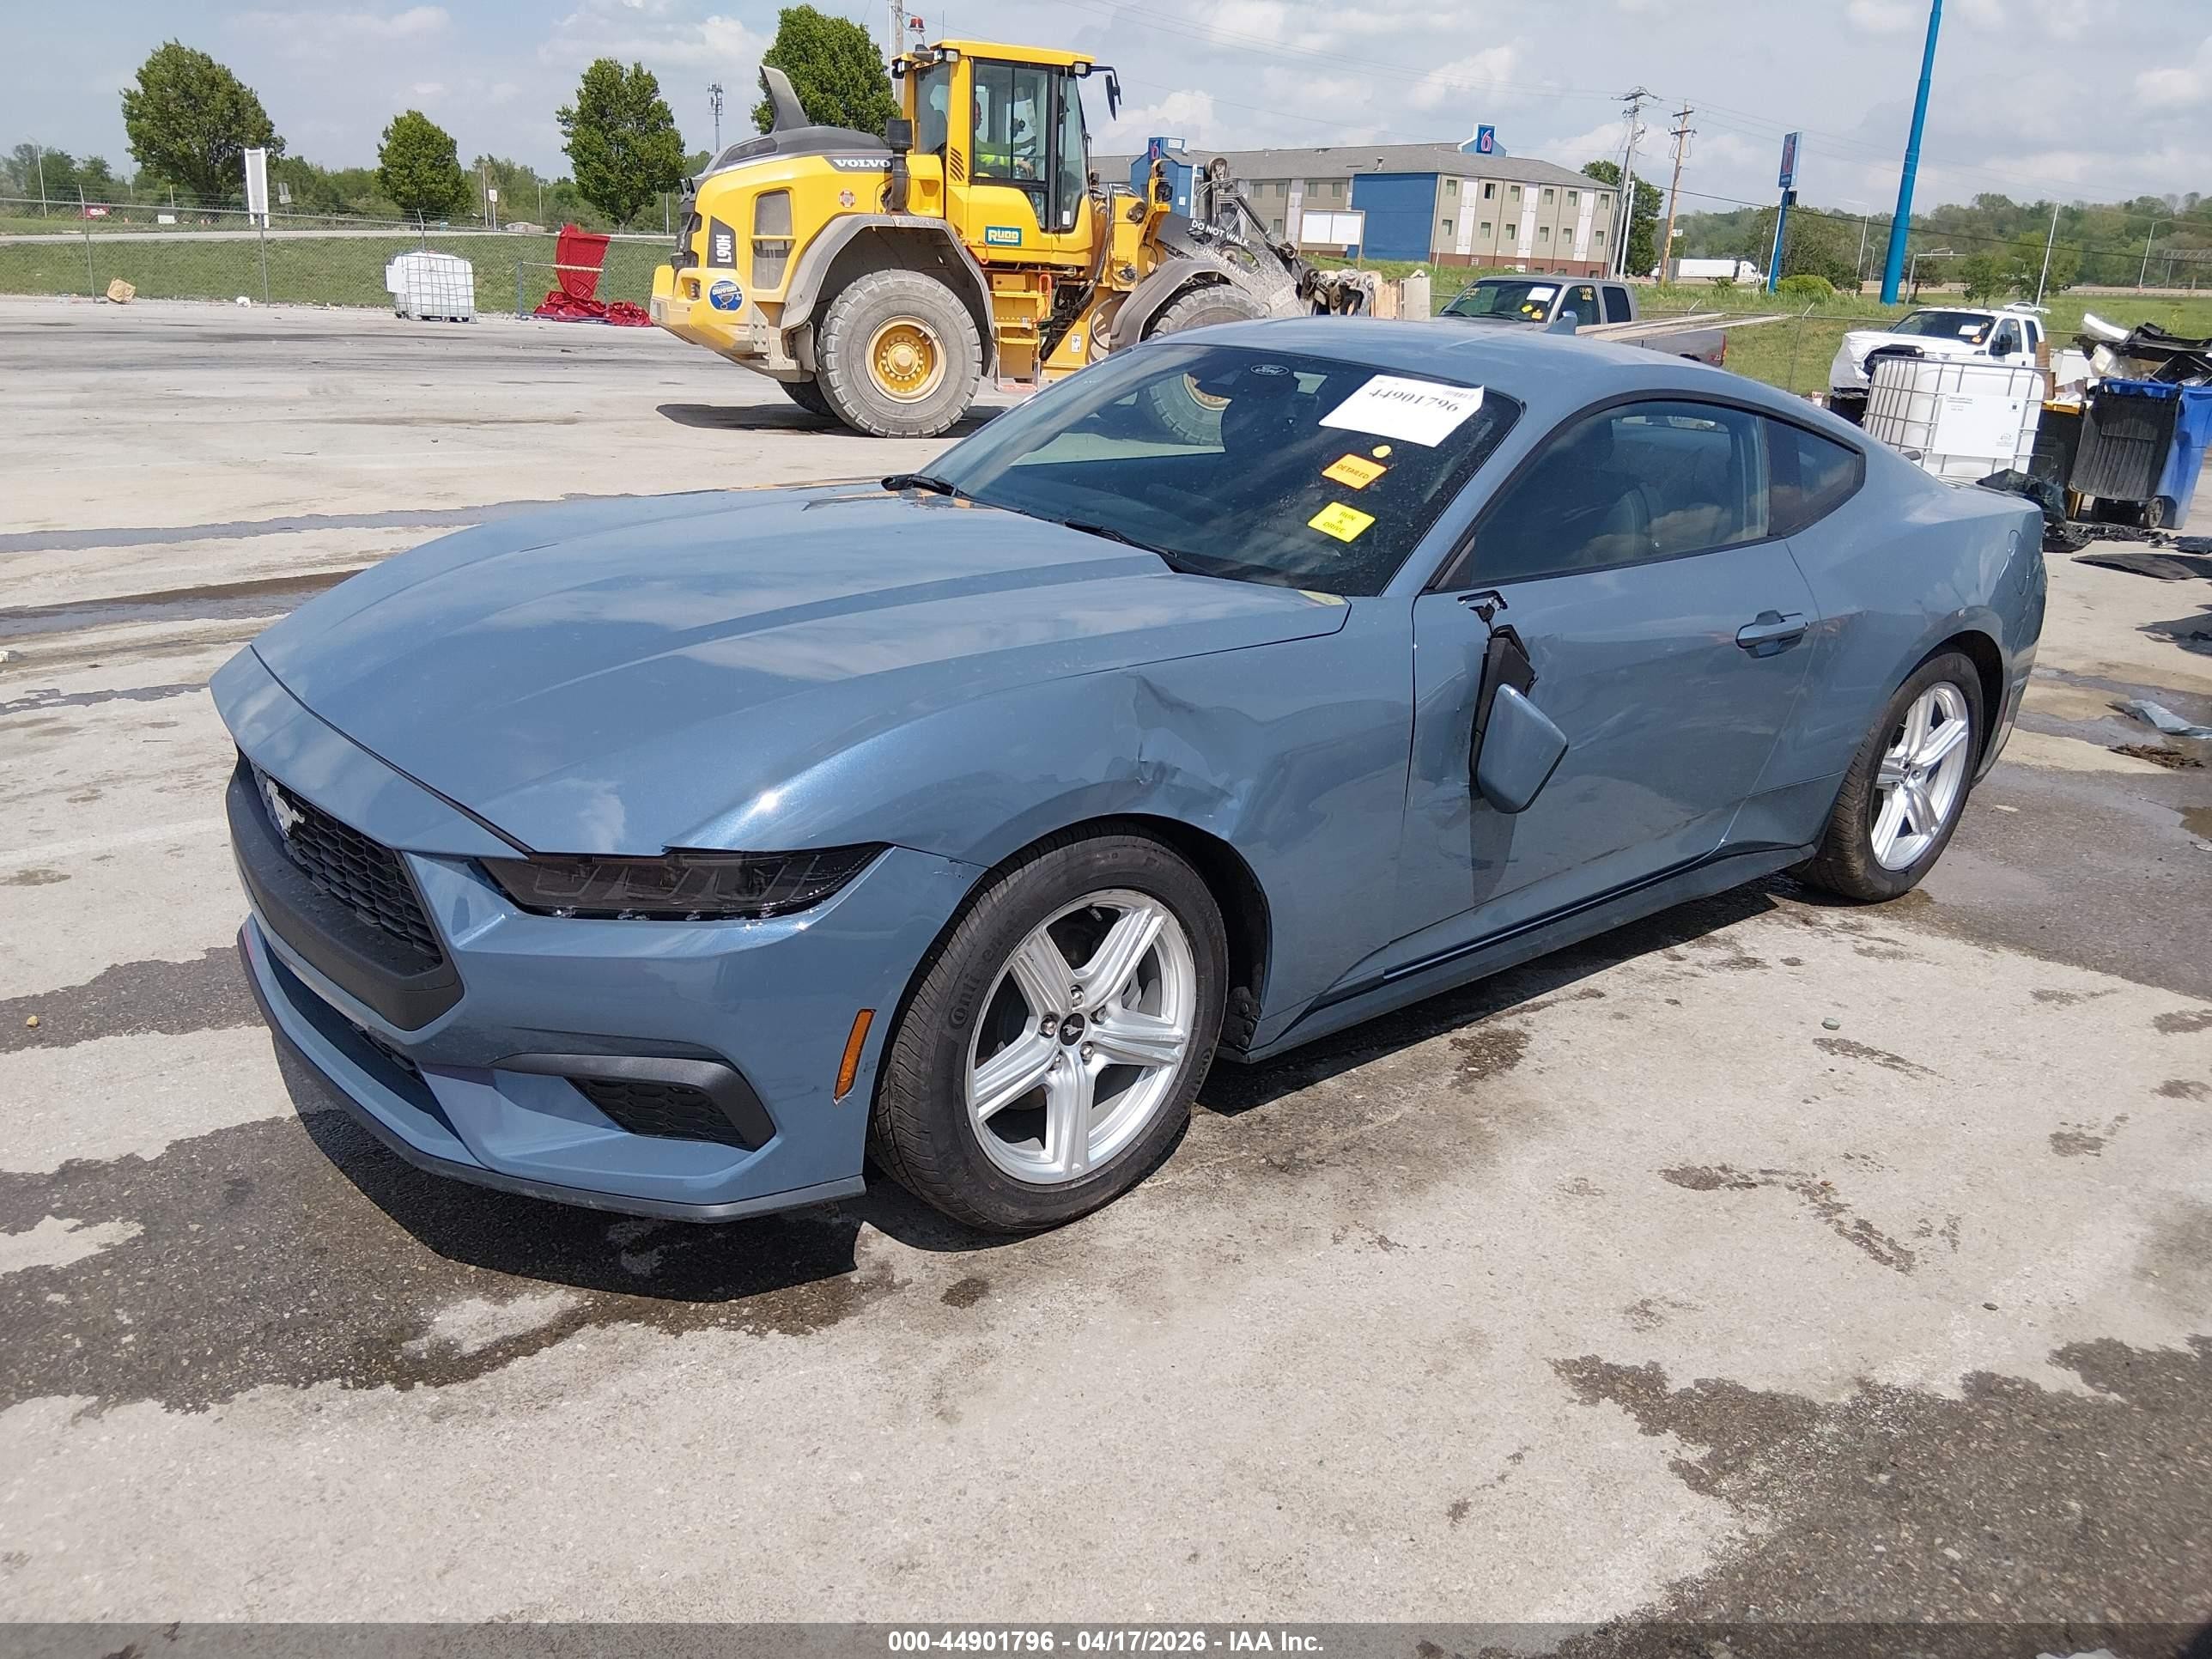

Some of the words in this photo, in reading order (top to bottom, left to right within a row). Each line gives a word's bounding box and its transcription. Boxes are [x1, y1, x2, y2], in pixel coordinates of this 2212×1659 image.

[1481, 130, 1492, 152] 6
[833, 159, 891, 167] VOLVO
[1191, 220, 1205, 231] DO
[1206, 225, 1225, 238] NOT
[1226, 232, 1250, 247] WALK
[1202, 247, 1229, 268] UNDER
[1228, 264, 1250, 280] MAST
[1369, 387, 1459, 412] 44901796
[1336, 464, 1370, 480] DETAILED
[1340, 511, 1356, 521] RUN
[1322, 521, 1346, 534] DRIVE
